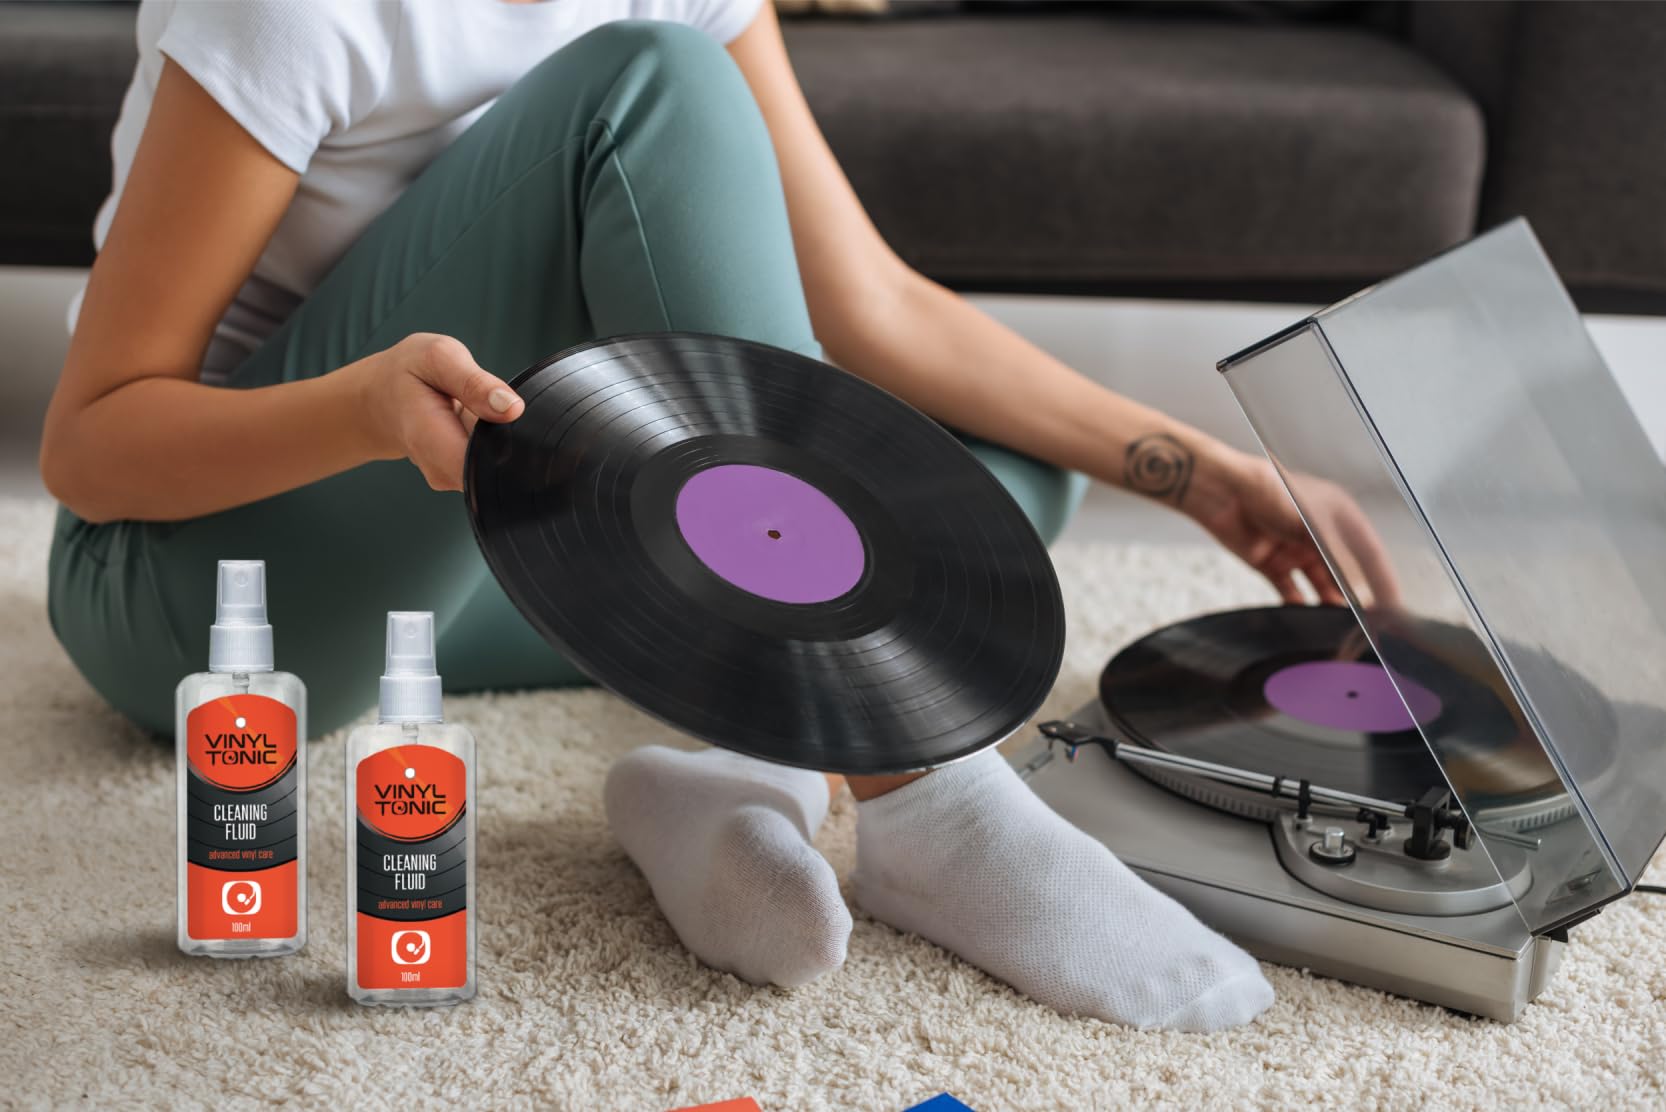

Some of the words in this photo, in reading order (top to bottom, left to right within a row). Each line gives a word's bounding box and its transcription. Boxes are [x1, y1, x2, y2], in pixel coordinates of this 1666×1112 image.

[205, 733, 277, 749] VINYL
[205, 750, 277, 766] TONIC
[374, 783, 446, 799] VINYL
[213, 803, 268, 821] CLEANING
[374, 800, 447, 816] TONIC
[225, 823, 257, 840] FLUID
[208, 850, 240, 860] advanced
[242, 850, 256, 861] vinyl
[258, 850, 274, 859] care
[383, 854, 437, 871] CLEANING
[394, 873, 426, 890] FLUID
[378, 900, 410, 910] advanced
[411, 900, 425, 911] vinyl
[427, 900, 443, 909] care
[231, 922, 251, 933] 100ml
[400, 971, 421, 982] 100ml
